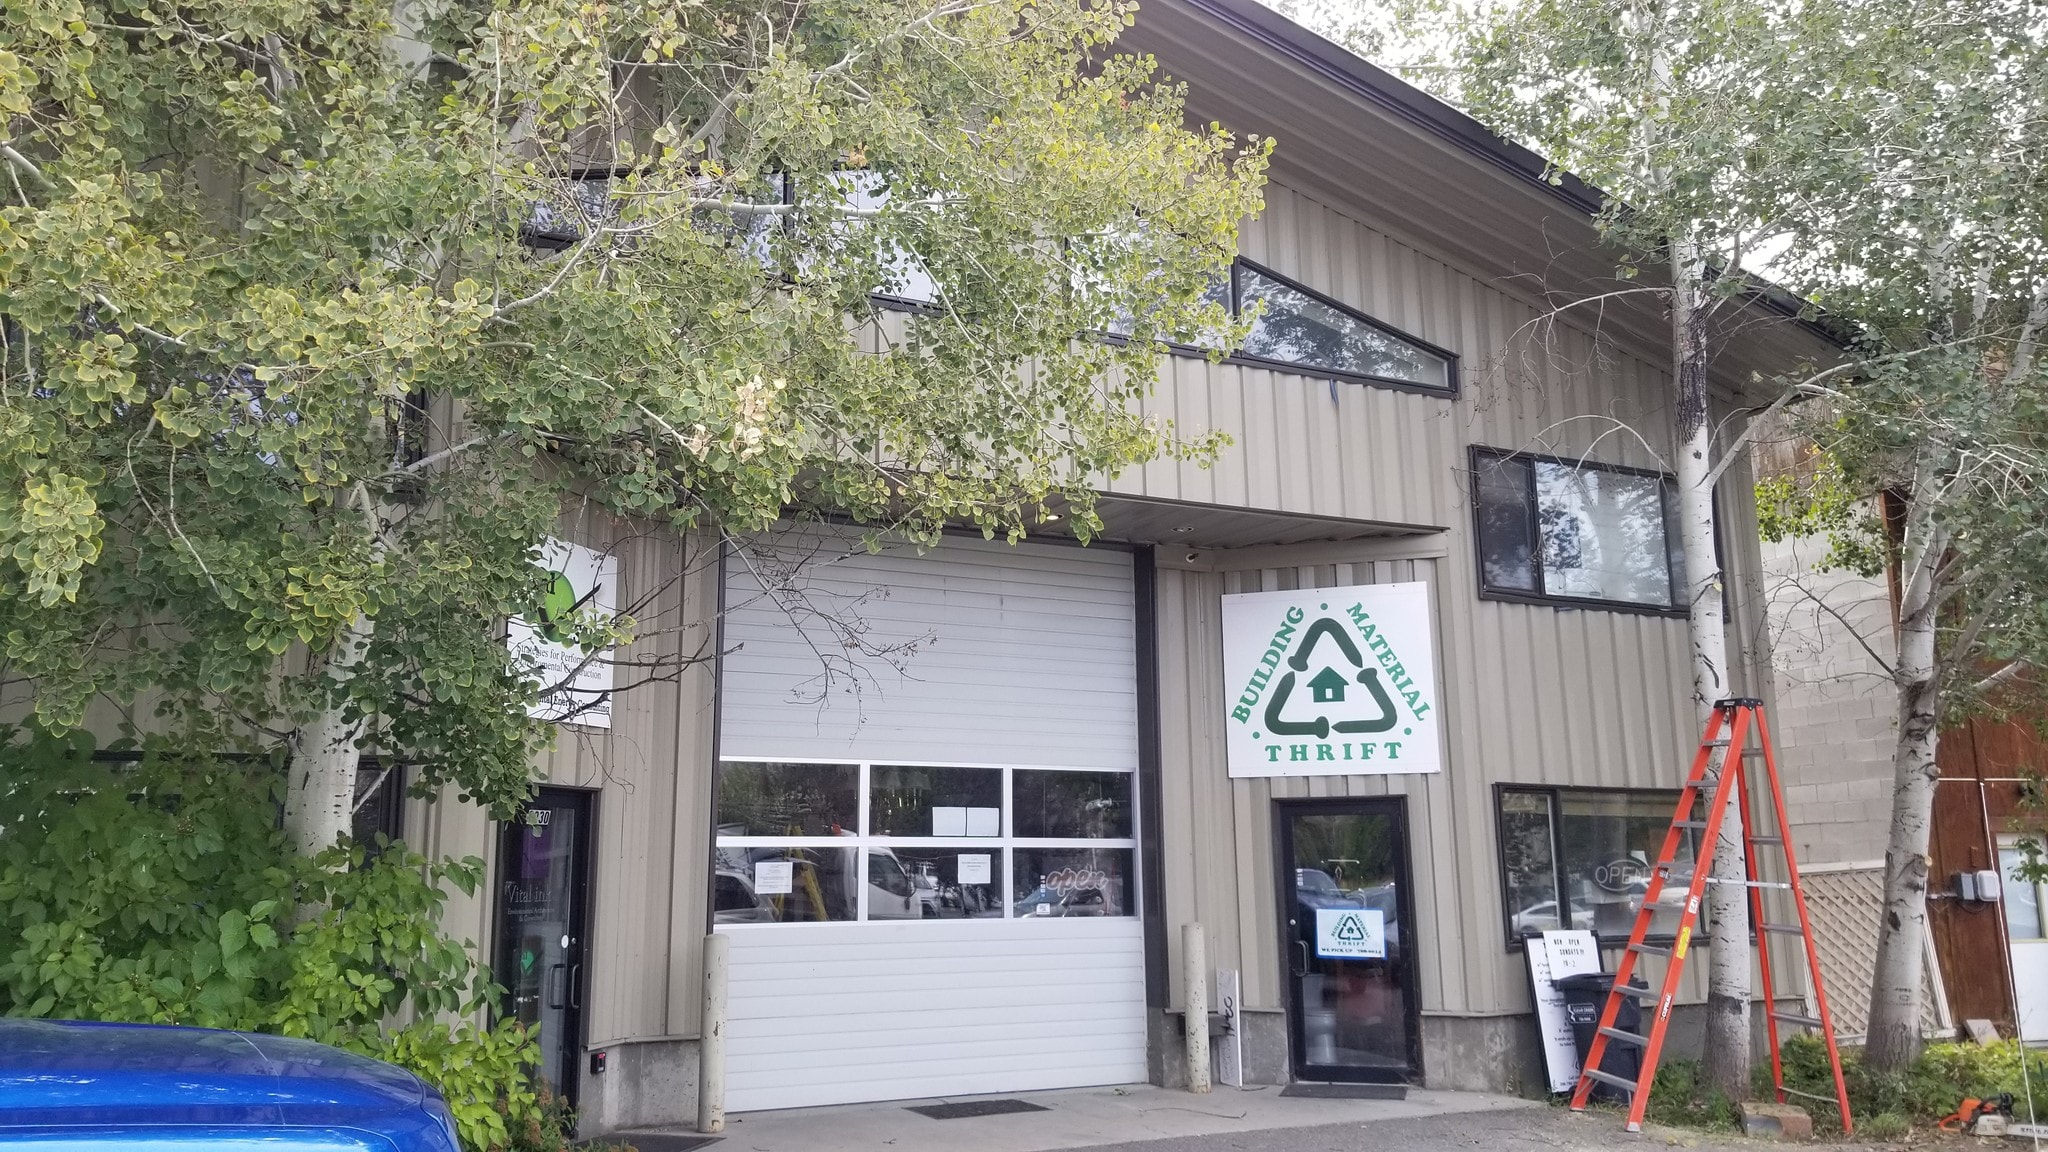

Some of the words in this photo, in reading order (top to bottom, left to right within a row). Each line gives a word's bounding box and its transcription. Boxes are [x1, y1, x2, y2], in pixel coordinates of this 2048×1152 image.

[550, 649, 561, 660] for
[1231, 606, 1304, 724] BUILDING
[1346, 602, 1430, 722] MATERIAL
[1265, 742, 1402, 762] THRIFT
[527, 810, 550, 824] 30
[1046, 867, 1109, 897] open
[1595, 866, 1647, 885] OPEN
[1331, 913, 1346, 937] BUILDING
[1355, 913, 1370, 938] MATERIAL
